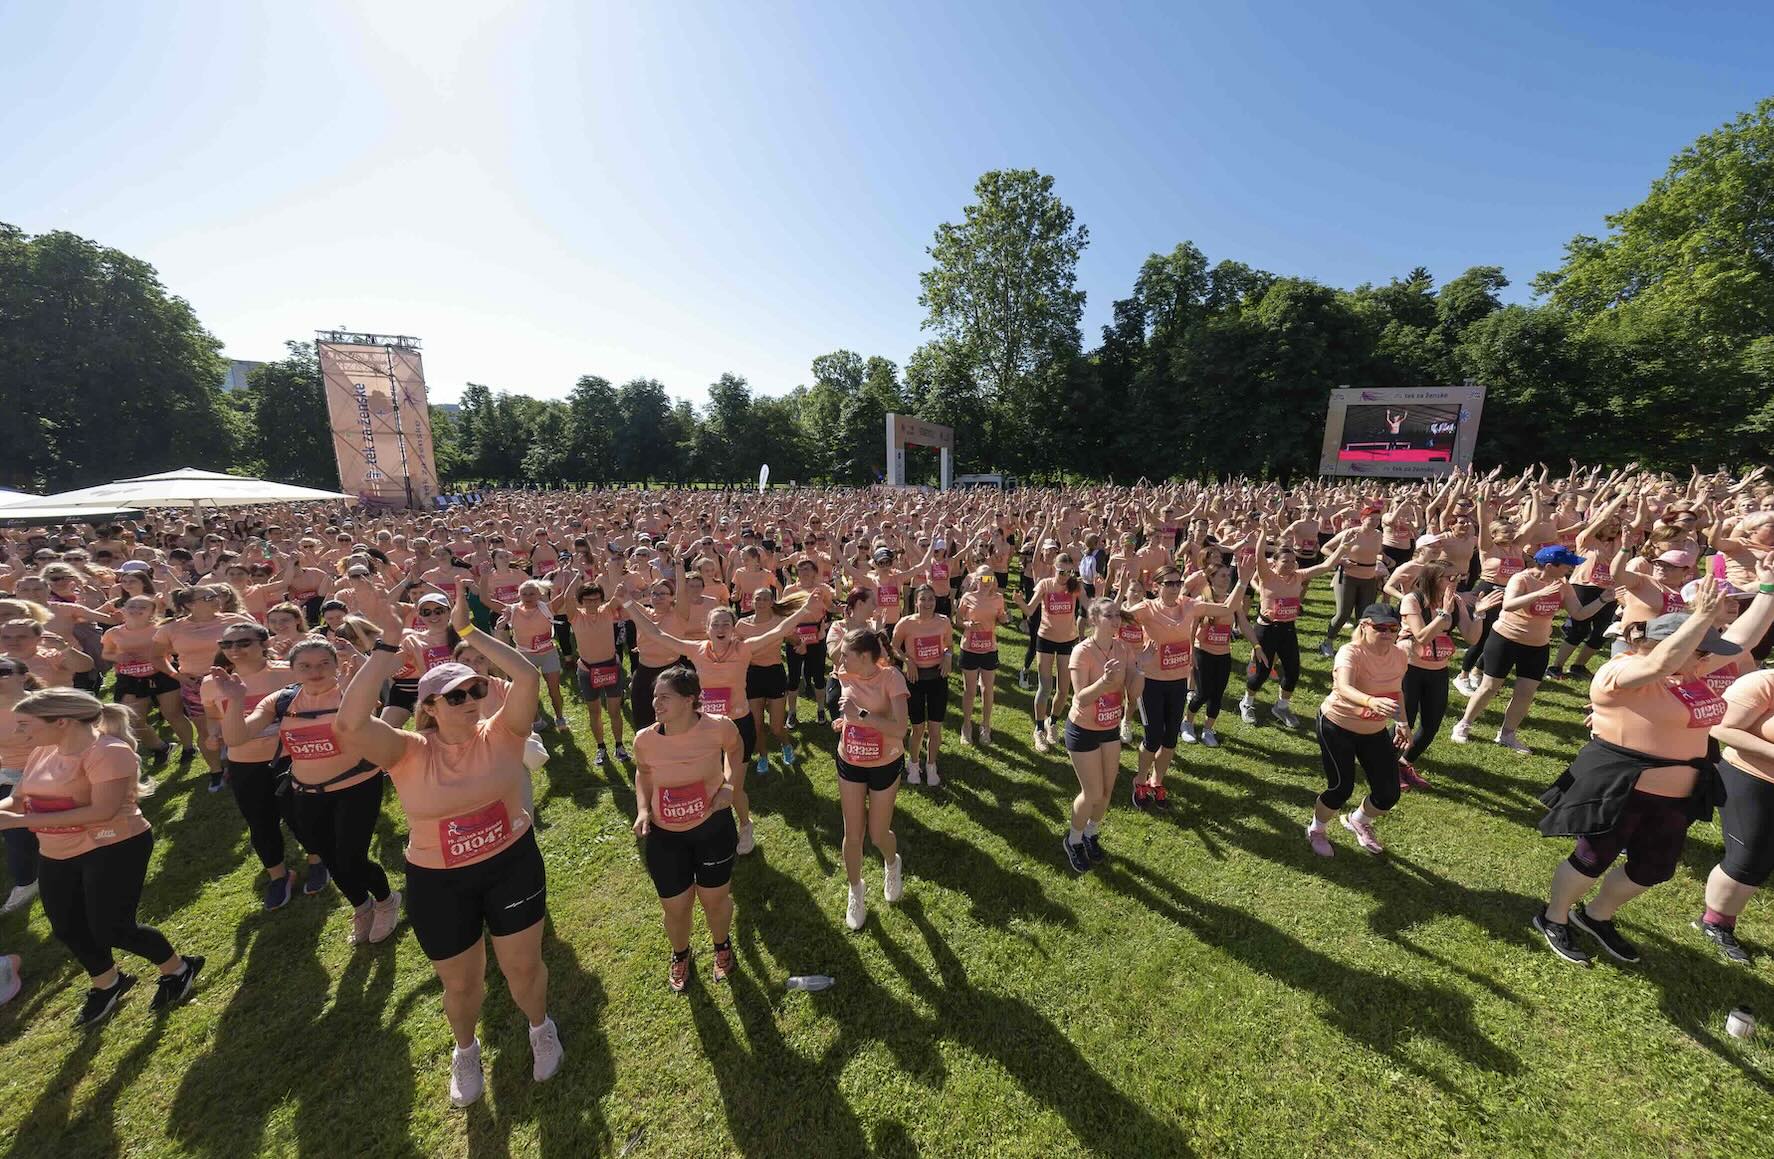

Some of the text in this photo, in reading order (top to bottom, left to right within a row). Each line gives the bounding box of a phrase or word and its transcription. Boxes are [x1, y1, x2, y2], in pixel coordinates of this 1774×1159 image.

[291, 742, 333, 753] 04760
[847, 744, 879, 756] 03322
[664, 801, 704, 818] 01048
[450, 824, 503, 856] 01047
